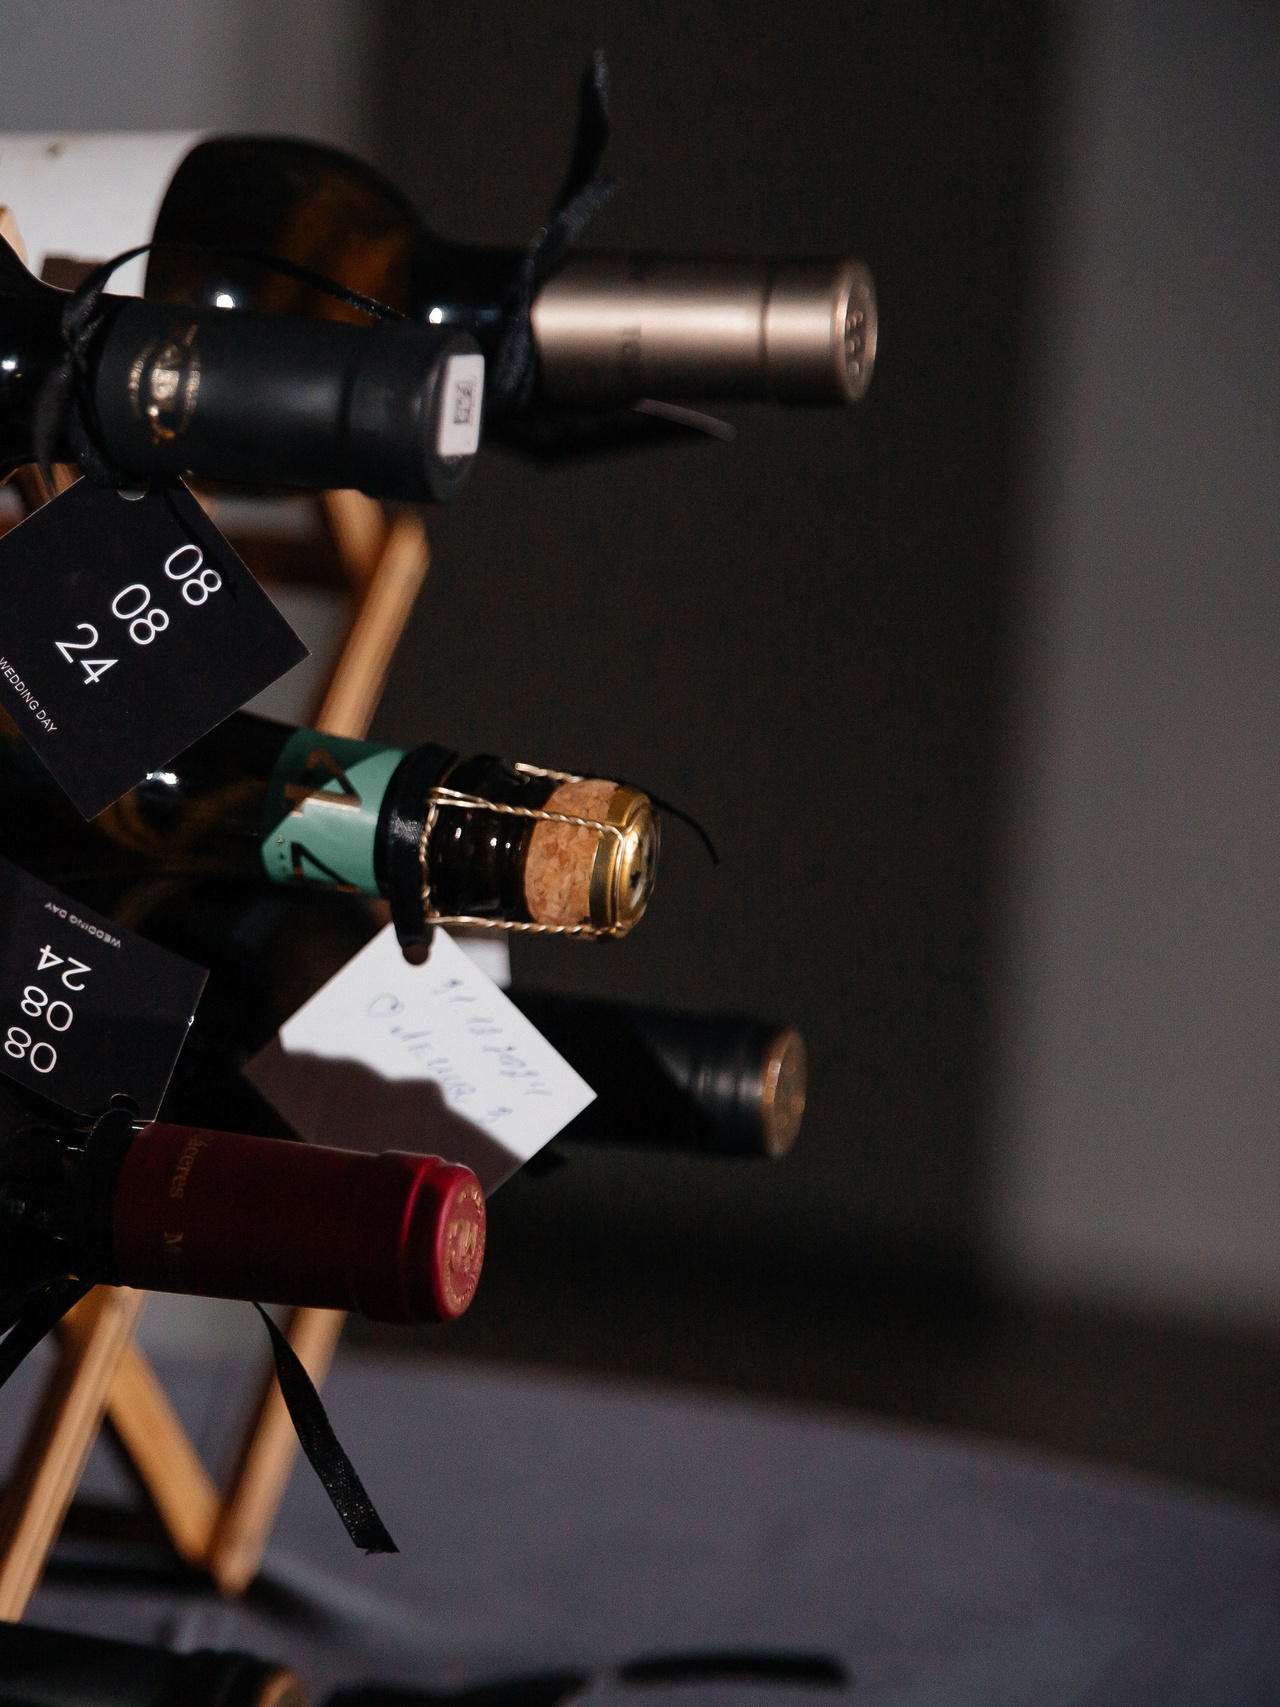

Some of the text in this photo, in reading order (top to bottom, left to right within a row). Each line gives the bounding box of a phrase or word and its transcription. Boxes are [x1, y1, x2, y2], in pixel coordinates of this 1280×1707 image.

[164, 544, 222, 606] 08
[111, 583, 170, 646] 08
[54, 622, 119, 685] 24
[35, 709, 58, 734] DAY
[44, 901, 122, 949] WEDDING DAY
[36, 944, 92, 992] 24
[20, 985, 74, 1032] 08
[4, 1026, 58, 1074] 08
